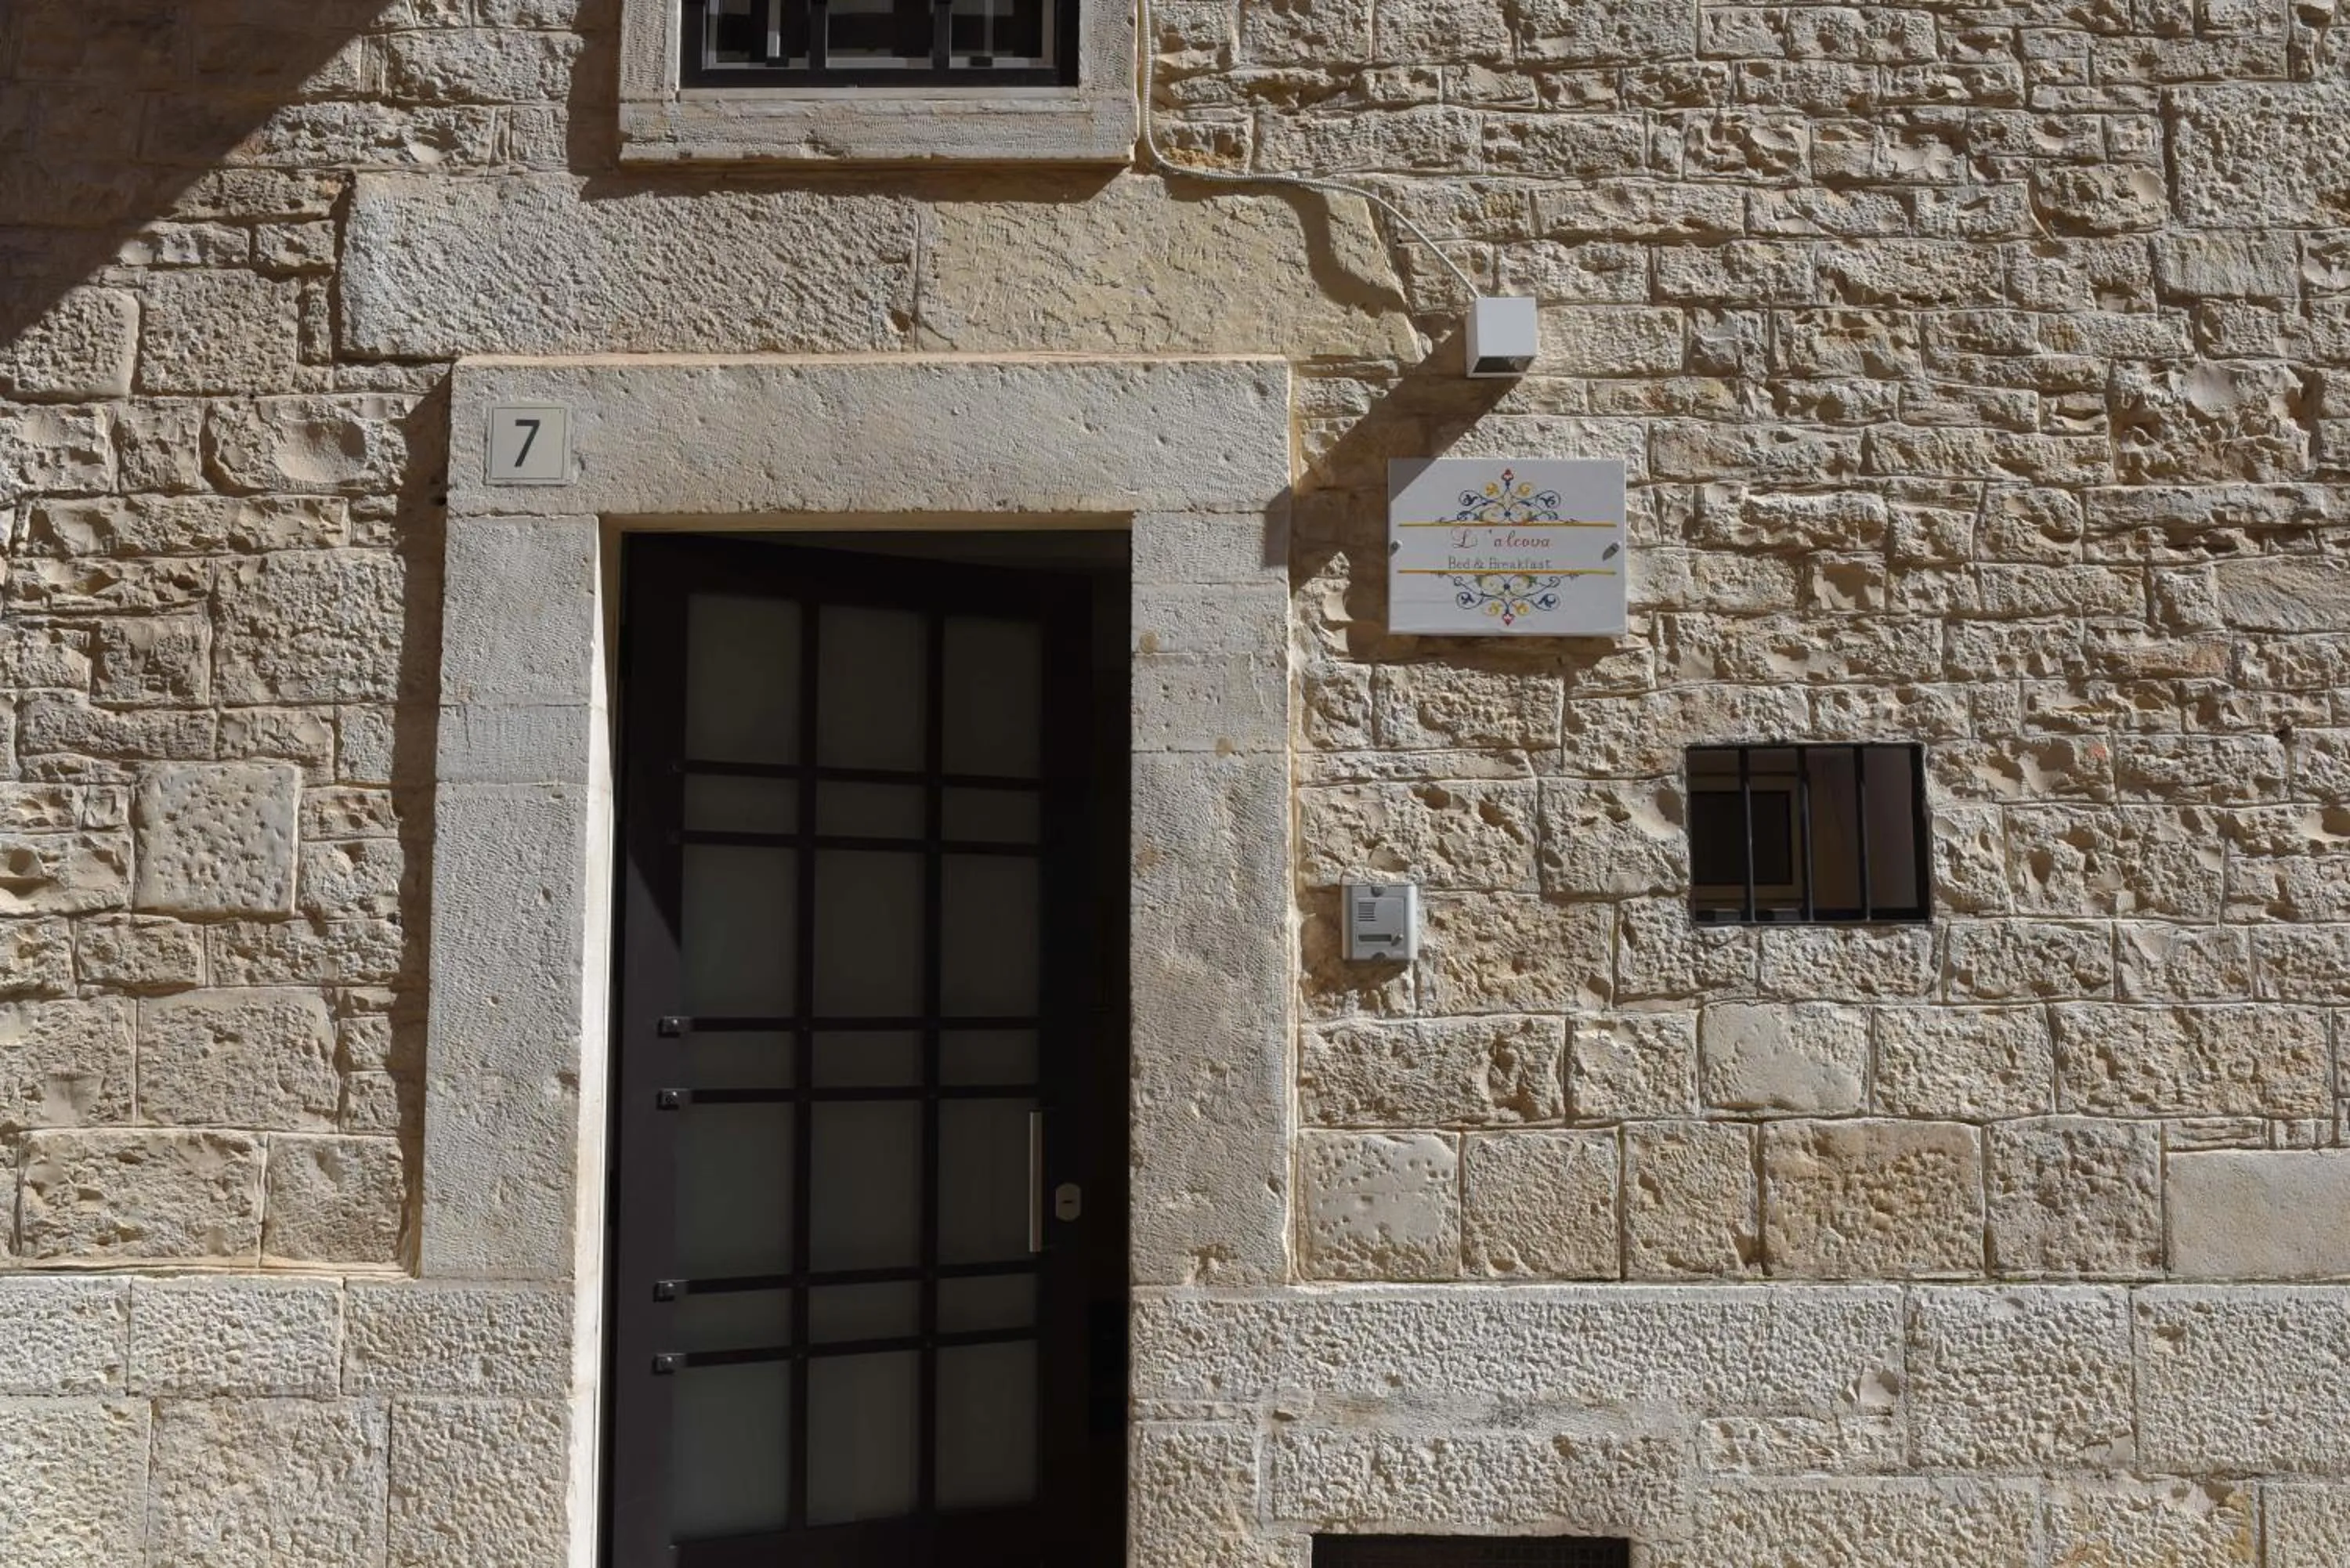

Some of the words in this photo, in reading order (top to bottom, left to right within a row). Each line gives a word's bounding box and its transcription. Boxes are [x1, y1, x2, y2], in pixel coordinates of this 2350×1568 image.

[514, 418, 540, 468] 7
[1448, 555, 1470, 569] Bed
[1473, 557, 1484, 569] &
[1489, 556, 1552, 569] Breakfast
